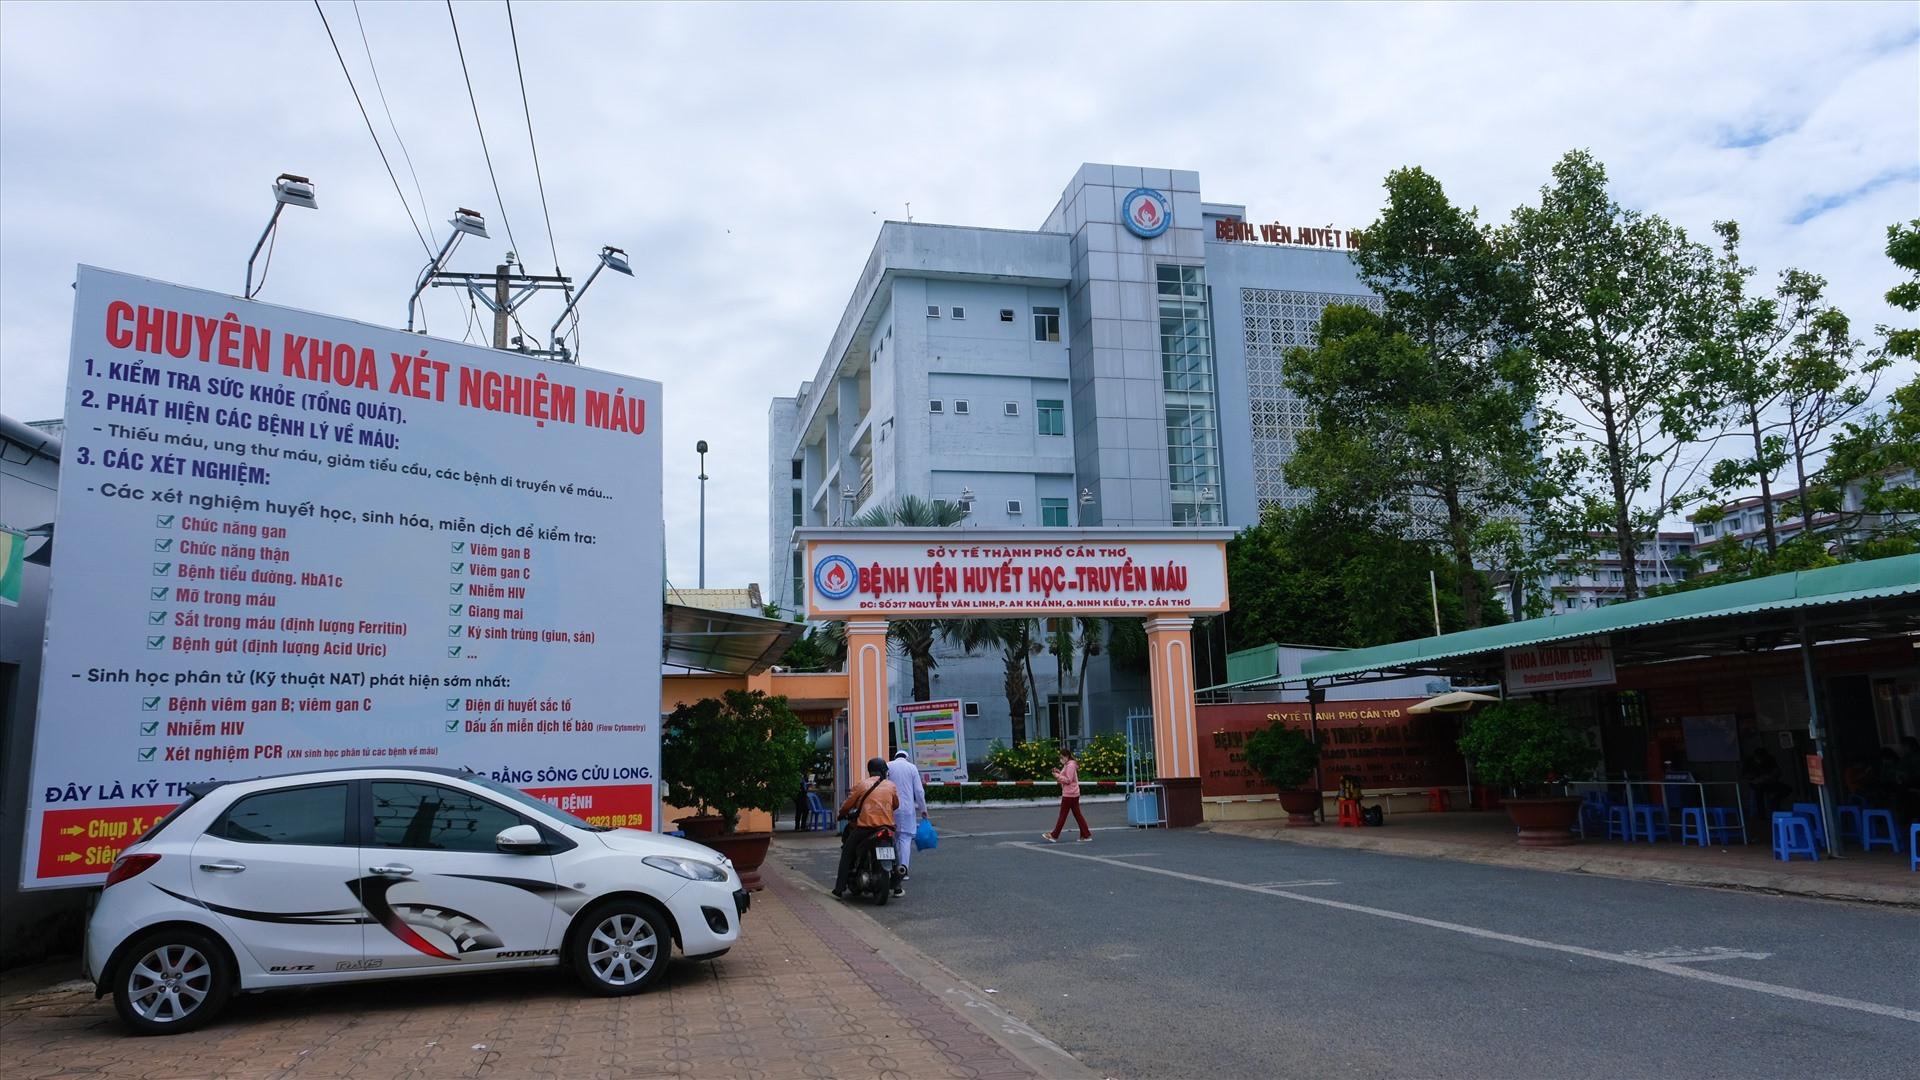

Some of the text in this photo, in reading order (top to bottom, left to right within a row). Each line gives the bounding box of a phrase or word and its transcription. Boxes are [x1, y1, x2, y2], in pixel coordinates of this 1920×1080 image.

[105, 300, 645, 435] CHUYÊN KHOA XÉT NGHIỆM MÁU
[84, 359, 407, 425] 1. KIỂM TRA SỨC KHỎE (TỔNG QUÁT).
[81, 389, 400, 450] 2. PHÁT HIỆN CÁC BỆNH LÝ VỀ MÁU:
[76, 447, 271, 486] 3. CÁC XÉT NGHIỆM:
[181, 516, 287, 539] Chức năng gan
[470, 542, 531, 561] Viêm gan B
[948, 549, 958, 558] Y
[962, 546, 979, 557] TẾ
[983, 547, 1031, 557] THÀNH
[1035, 546, 1062, 557] PHỐ
[1099, 547, 1128, 557] THƠ
[178, 563, 215, 582] Bệnh
[220, 565, 247, 582] tiểu
[301, 573, 343, 588] HbA1c
[859, 562, 909, 599] BỆNH
[914, 562, 957, 600] VIỆN
[963, 558, 1023, 592] HUYẾT
[1151, 560, 1187, 592] MÁU
[469, 583, 525, 600] Nhiễm HIV
[860, 601, 877, 609] ĐC:
[878, 599, 892, 608] SỐ
[952, 600, 970, 608] VĂN
[175, 610, 407, 636] Sắt trong máu (định lượng Ferritin)
[484, 627, 508, 640] sinh
[541, 629, 571, 644] (giun,
[87, 668, 511, 690] Sinh học phân tử (Kỹ thuật NAT) phát hiện sớm nhất:
[168, 697, 372, 714] Bệnh viêm gan B; viêm gan C
[465, 697, 571, 715] Điện di huyết sắc tố
[166, 719, 245, 736] Nhiễm HIV
[464, 719, 486, 733] Dấu
[490, 719, 503, 732] ấn
[506, 718, 533, 732] miễn
[536, 721, 560, 735] dịch
[562, 718, 573, 731] tế
[575, 719, 594, 732] bào
[165, 746, 190, 761] Xét
[194, 746, 249, 763] nghiệm
[253, 745, 282, 760] PCR
[45, 785, 92, 802] ĐÂY
[99, 782, 125, 800] LÀ
[131, 779, 159, 798] KỸ
[492, 766, 533, 783] BẰNG
[537, 769, 578, 783] SÔNG
[582, 765, 609, 780] CỬU
[613, 767, 653, 779] LONG.
[562, 793, 592, 813] BỆNH
[612, 815, 626, 826] 899
[628, 814, 642, 825] 259
[88, 820, 128, 841] Chụp
[335, 958, 383, 971] RAYS
[495, 948, 560, 959] POTENZA
